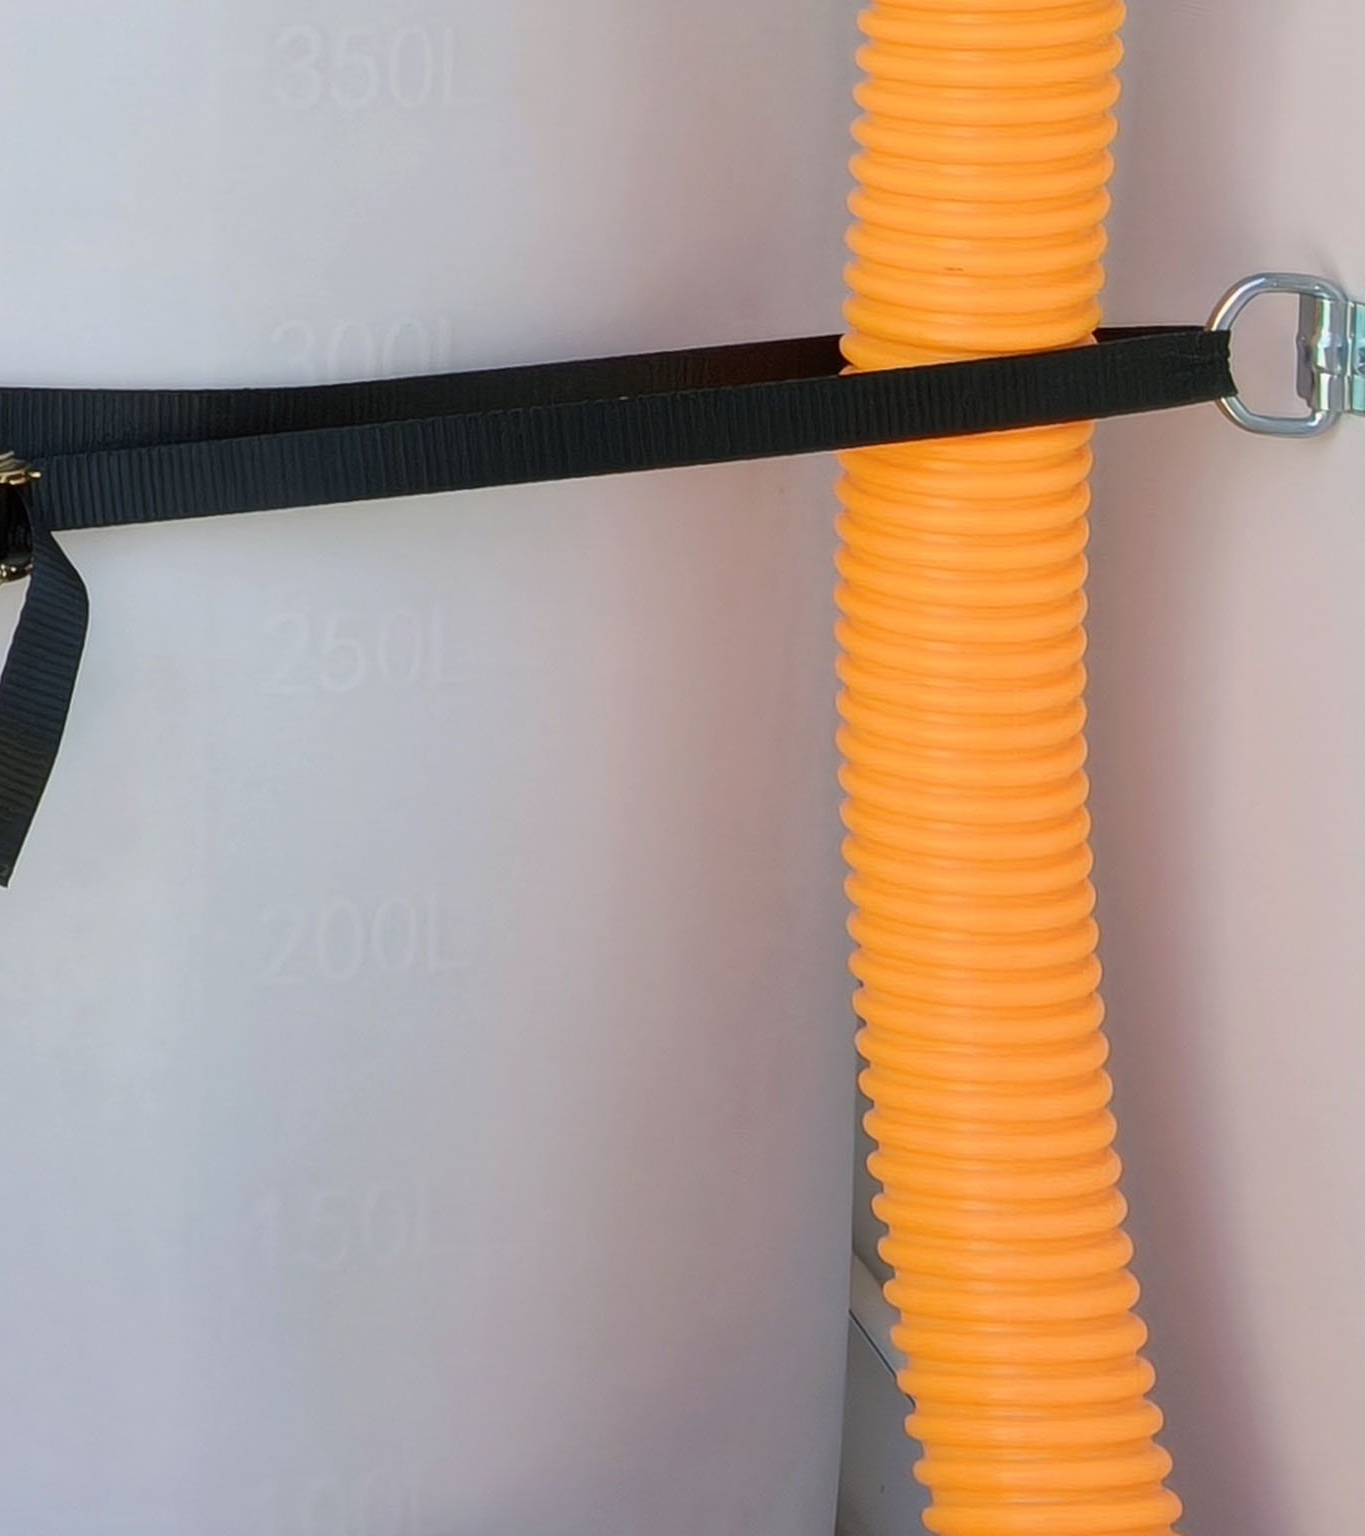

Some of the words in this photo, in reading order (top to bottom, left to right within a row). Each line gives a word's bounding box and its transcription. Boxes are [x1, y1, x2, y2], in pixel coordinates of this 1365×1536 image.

[274, 24, 484, 110] 350L
[259, 602, 475, 694] 250L
[258, 890, 470, 985] 200L
